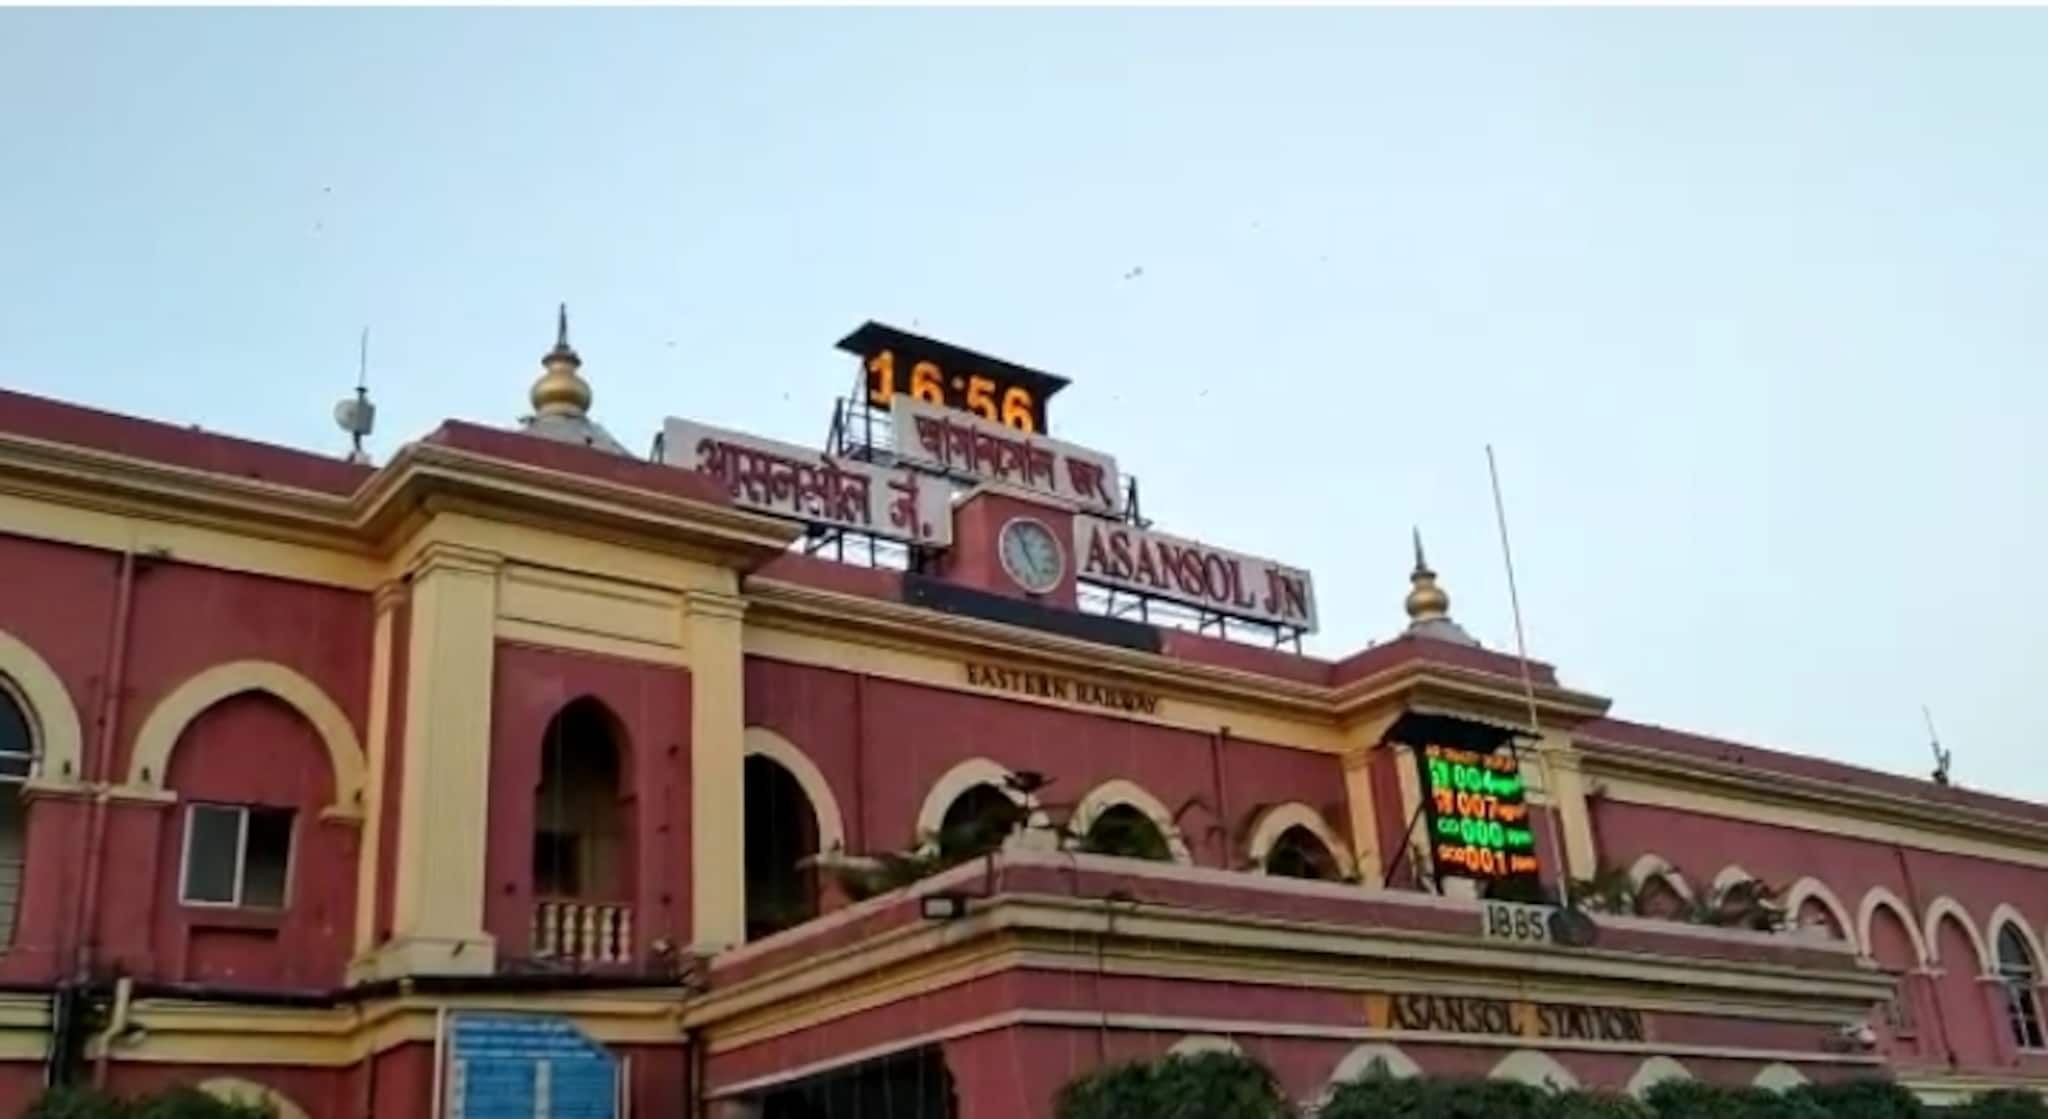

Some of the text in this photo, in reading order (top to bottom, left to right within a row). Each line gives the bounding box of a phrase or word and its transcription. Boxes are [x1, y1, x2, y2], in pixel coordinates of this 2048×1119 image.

[1086, 525, 1307, 619] ASANSOL JN
[966, 662, 1159, 714] EASTERN RAILWAY
[1488, 906, 1544, 938] 1885
[1386, 993, 1646, 1042] ASANSOL STATION
